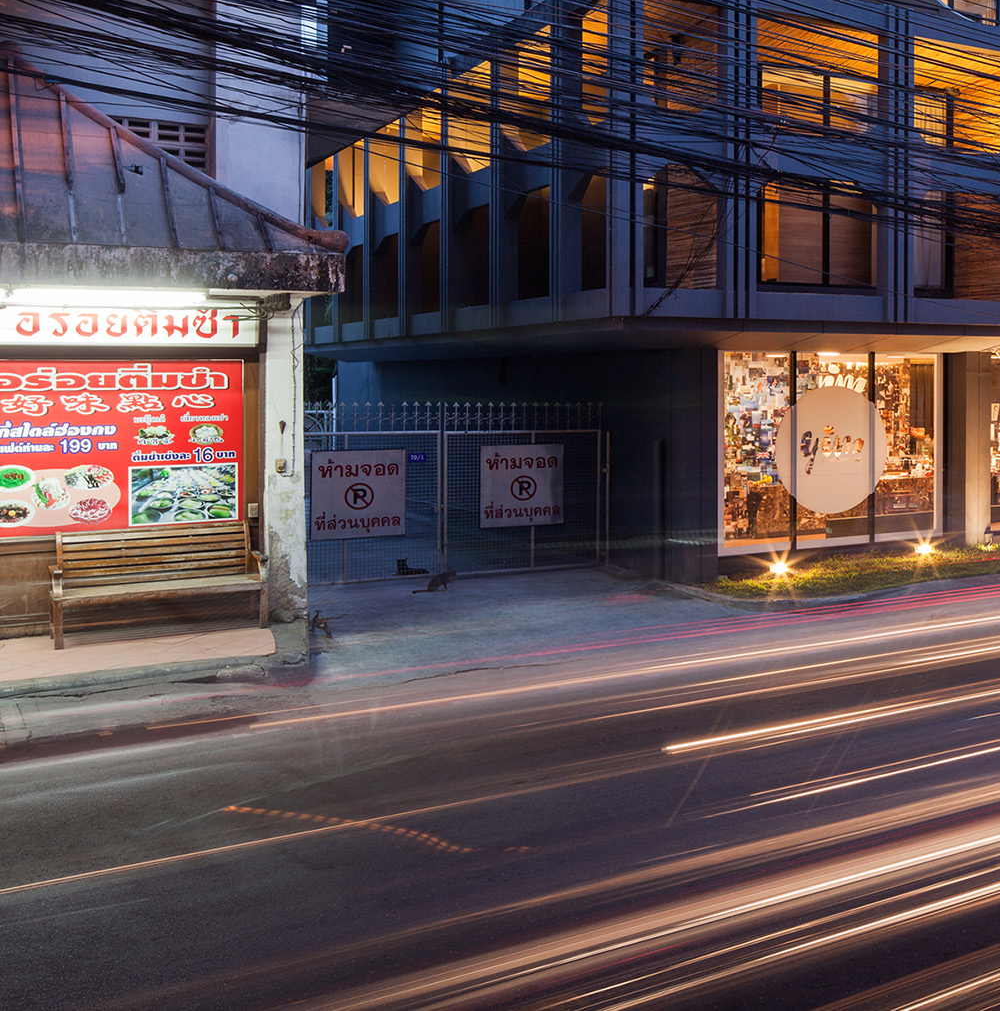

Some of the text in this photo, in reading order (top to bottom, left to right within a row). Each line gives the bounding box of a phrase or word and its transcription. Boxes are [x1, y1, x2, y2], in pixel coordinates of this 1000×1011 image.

[59, 438, 92, 453] 199
[193, 447, 215, 462] 16
[215, 450, 236, 459] บาท
[318, 458, 399, 478] ห้ามจอด
[485, 452, 558, 470] ห้ามจอด
[483, 501, 560, 521] ที่ส่วนบุคคล
[314, 511, 400, 533] ที่ส่วนบุคคล
